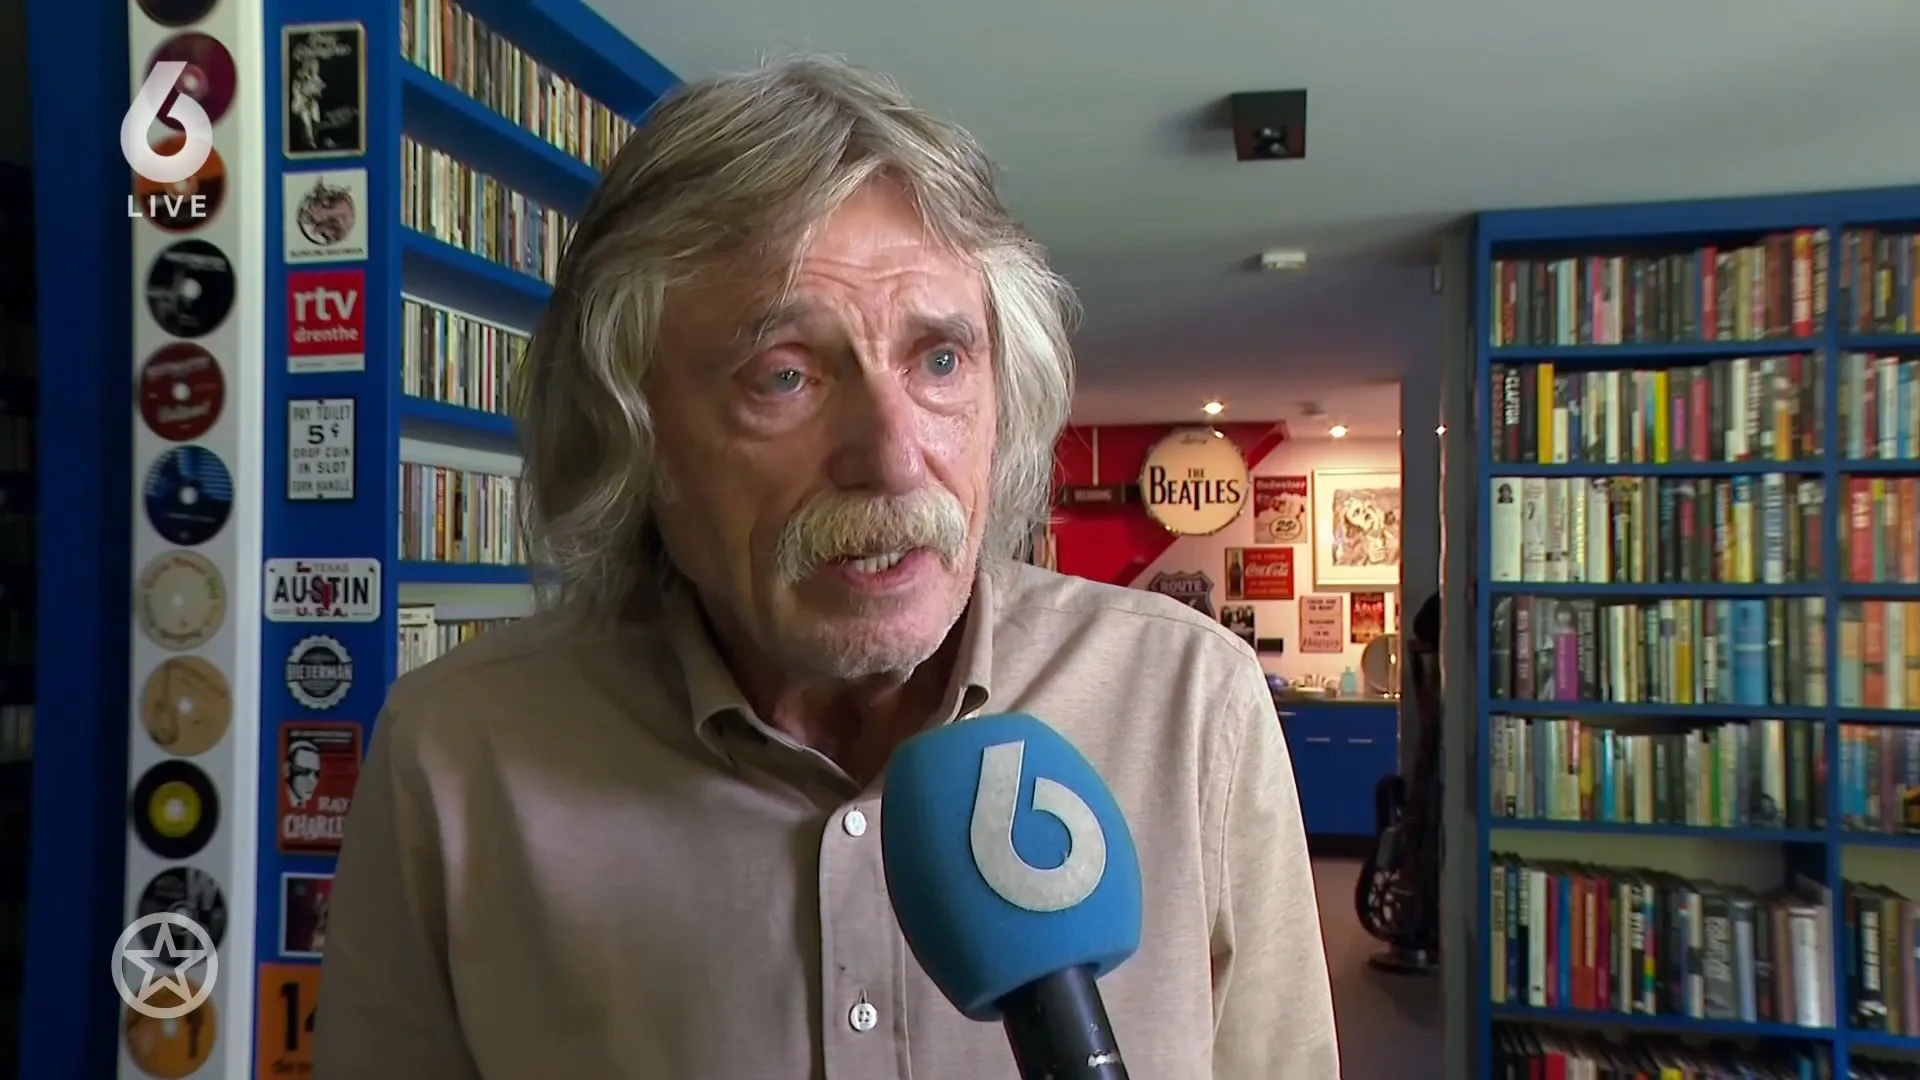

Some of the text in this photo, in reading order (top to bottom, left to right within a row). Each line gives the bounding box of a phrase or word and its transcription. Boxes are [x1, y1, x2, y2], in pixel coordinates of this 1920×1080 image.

[293, 286, 358, 322] rtv
[294, 325, 359, 343] drenthe
[316, 461, 347, 474] SLOT
[1188, 468, 1205, 479] THE
[1150, 466, 1240, 511] BEATLES
[315, 563, 349, 573] TEXAS
[273, 576, 369, 604] AUSTIN
[1161, 581, 1202, 593] ROUTE
[317, 796, 351, 813] RAY
[283, 814, 345, 840] CHARLE
[971, 740, 1106, 912] 6
[279, 981, 318, 1052] 1
